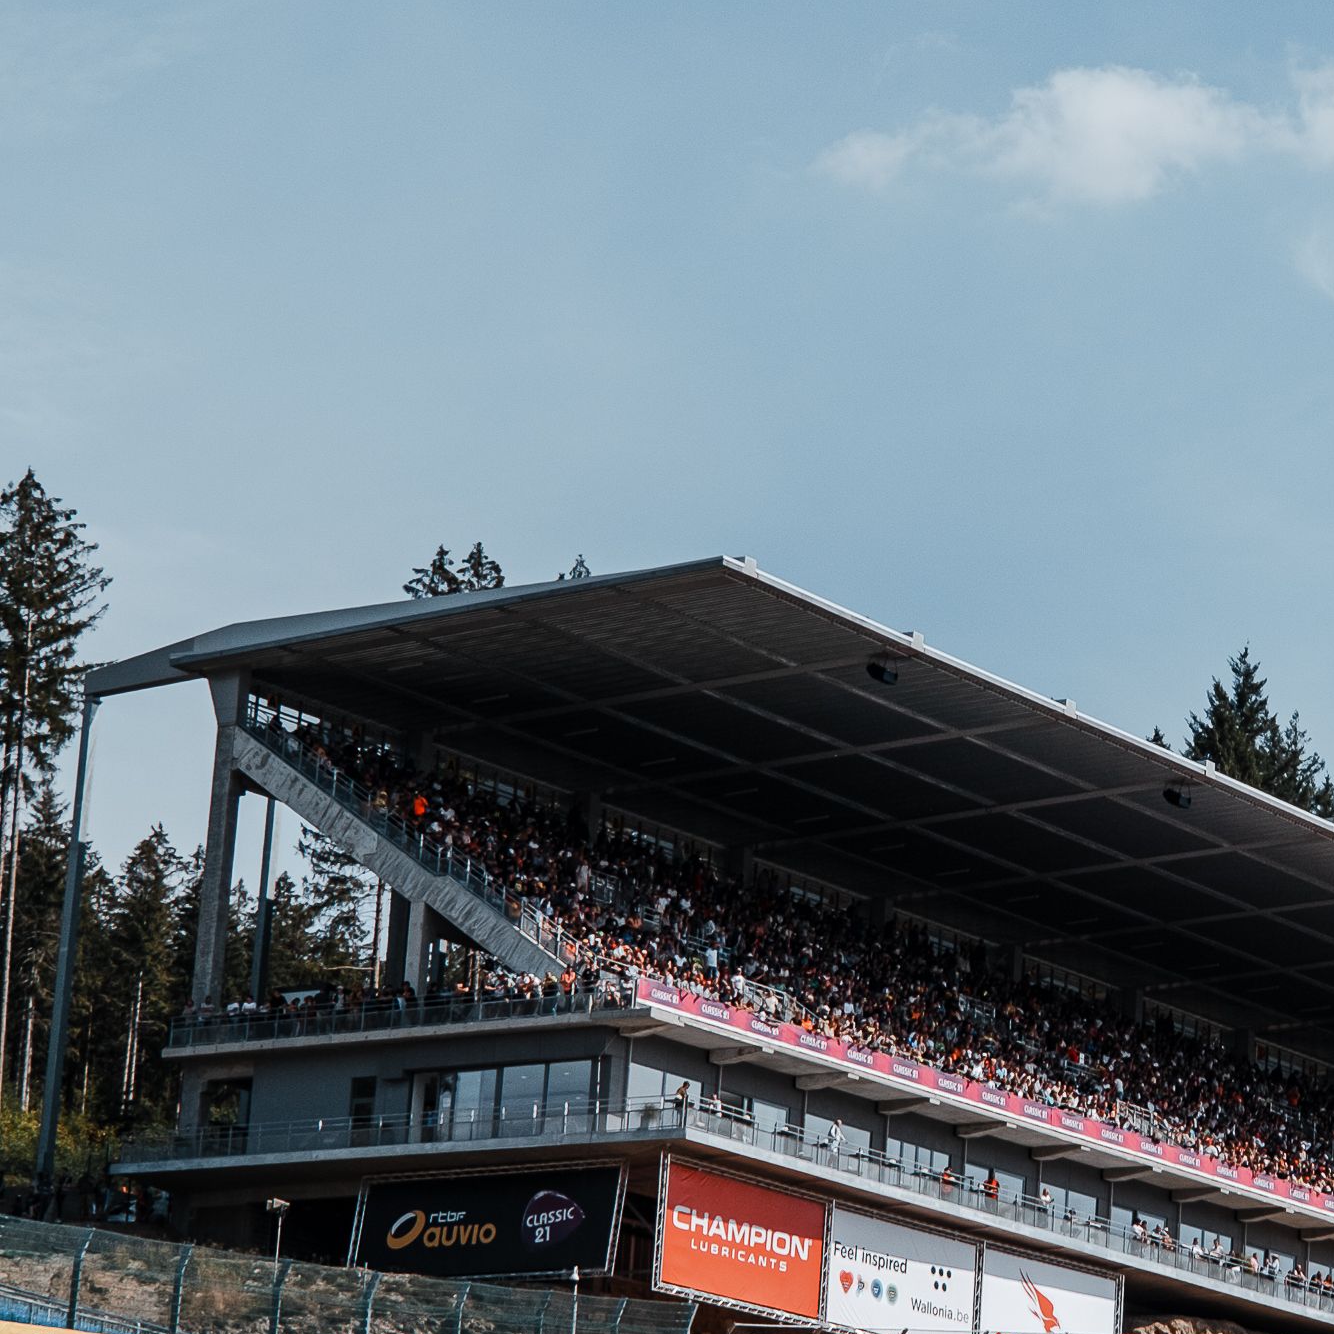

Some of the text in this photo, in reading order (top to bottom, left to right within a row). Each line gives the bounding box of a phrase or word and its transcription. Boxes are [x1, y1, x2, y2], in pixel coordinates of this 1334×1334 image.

[702, 1004, 723, 1017] CLASSIC
[526, 1206, 575, 1228] CLASSIC
[534, 1226, 550, 1243] 21
[672, 1204, 810, 1261] CHAMPION
[690, 1238, 787, 1272] LUBRICANTS
[833, 1241, 908, 1274] Feel inspired
[911, 1297, 969, 1324] Wallonia.be
